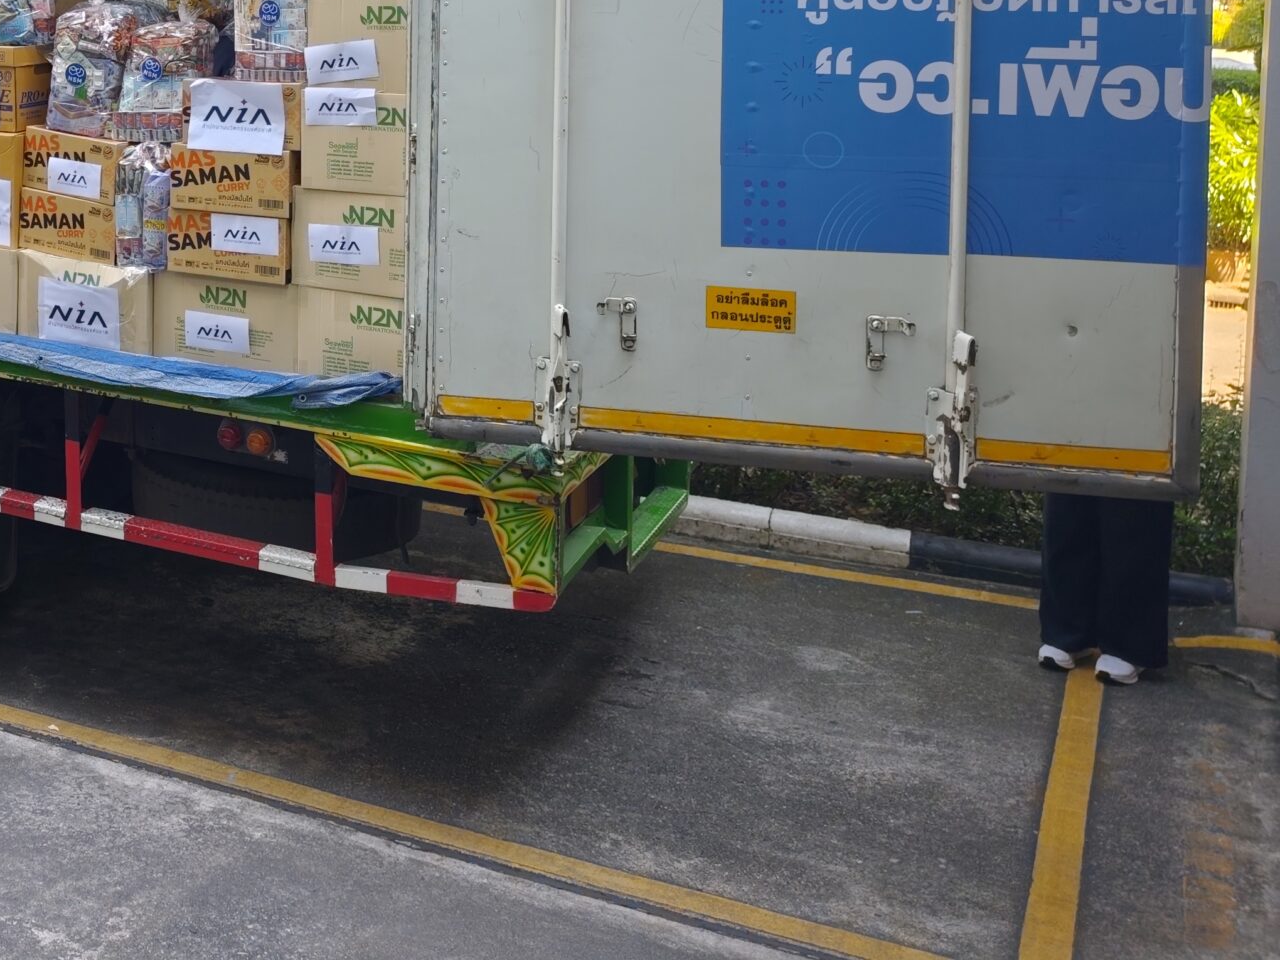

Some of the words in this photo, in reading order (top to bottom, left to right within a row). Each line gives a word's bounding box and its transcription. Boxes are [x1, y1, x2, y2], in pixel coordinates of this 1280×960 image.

[377, 107, 406, 127] 2N
[24, 134, 60, 152] MAS
[169, 150, 216, 169] MAS
[170, 163, 251, 188] SAMAN
[216, 182, 251, 193] CURRY
[22, 195, 58, 212] MAS
[20, 213, 85, 230] SAMAN
[348, 205, 395, 228] N2N
[56, 229, 85, 239] CURRY
[205, 285, 247, 309] N2N
[356, 305, 403, 330] N2N
